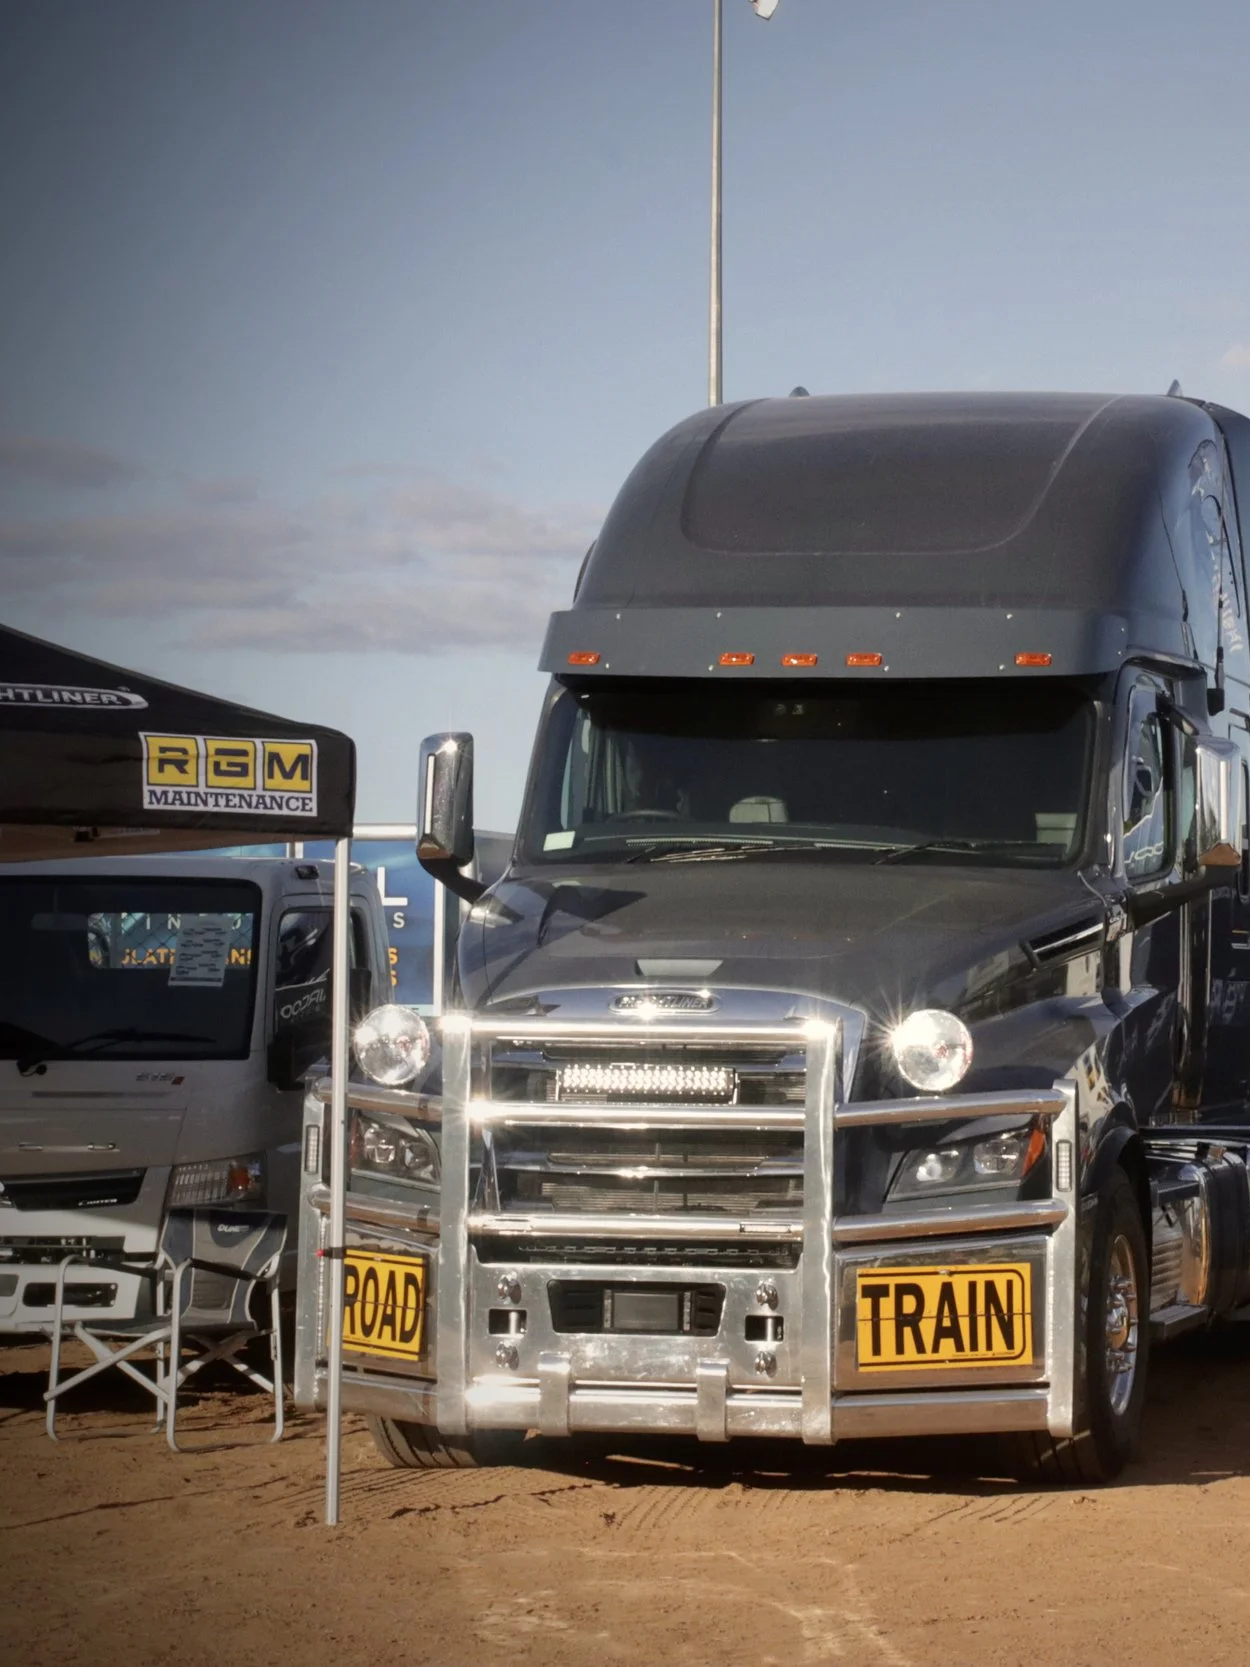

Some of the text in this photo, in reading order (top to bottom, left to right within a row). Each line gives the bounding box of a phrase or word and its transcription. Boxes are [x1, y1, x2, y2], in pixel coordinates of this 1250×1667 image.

[158, 745, 308, 781] RGM
[148, 790, 313, 813] MAINTENANCE
[344, 1263, 421, 1344] ROAD
[861, 1279, 1015, 1357] TRAIN
